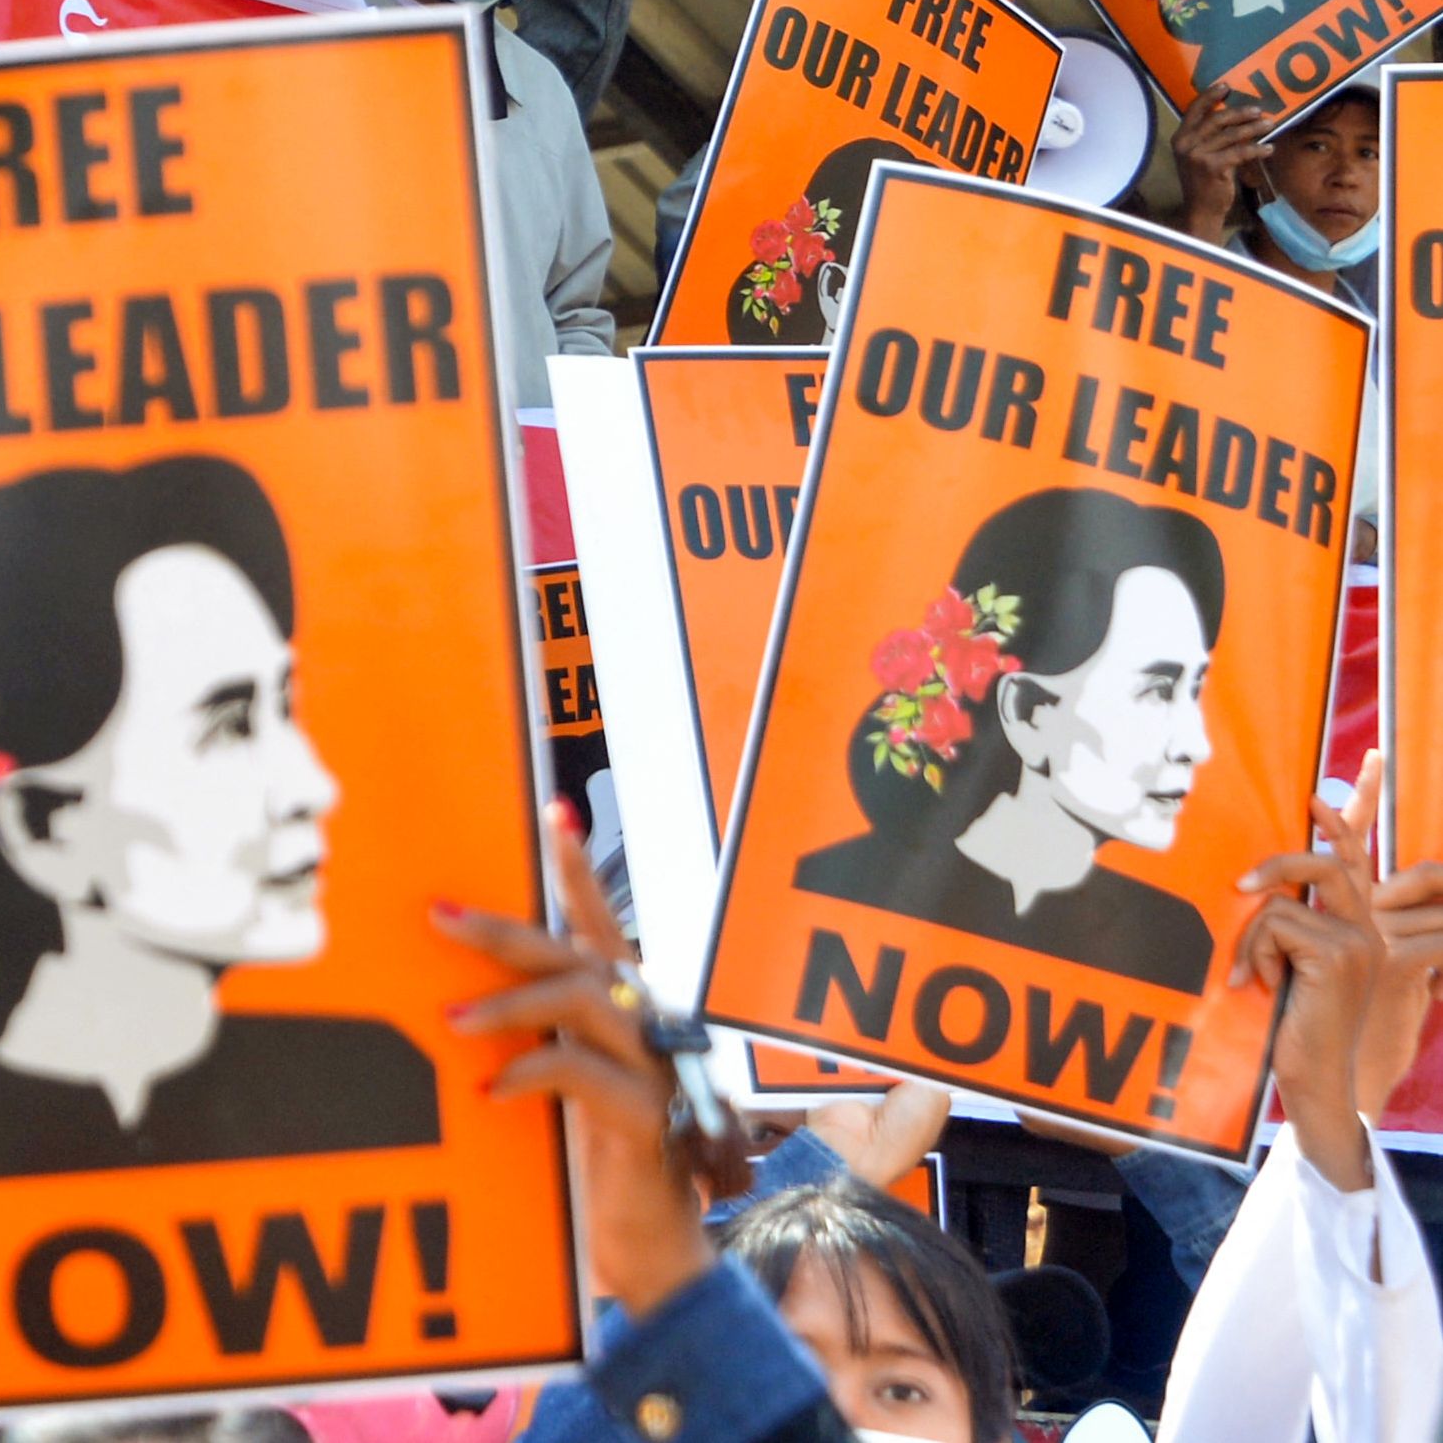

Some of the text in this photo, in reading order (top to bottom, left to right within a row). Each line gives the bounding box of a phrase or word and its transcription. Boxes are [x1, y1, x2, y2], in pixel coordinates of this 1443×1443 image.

[763, 6, 1025, 184] OUR LEADER
[1046, 232, 1234, 371] FREE
[856, 328, 1046, 450] OUR
[1062, 374, 1338, 548] LEADER
[794, 928, 1195, 1123] NOW!
